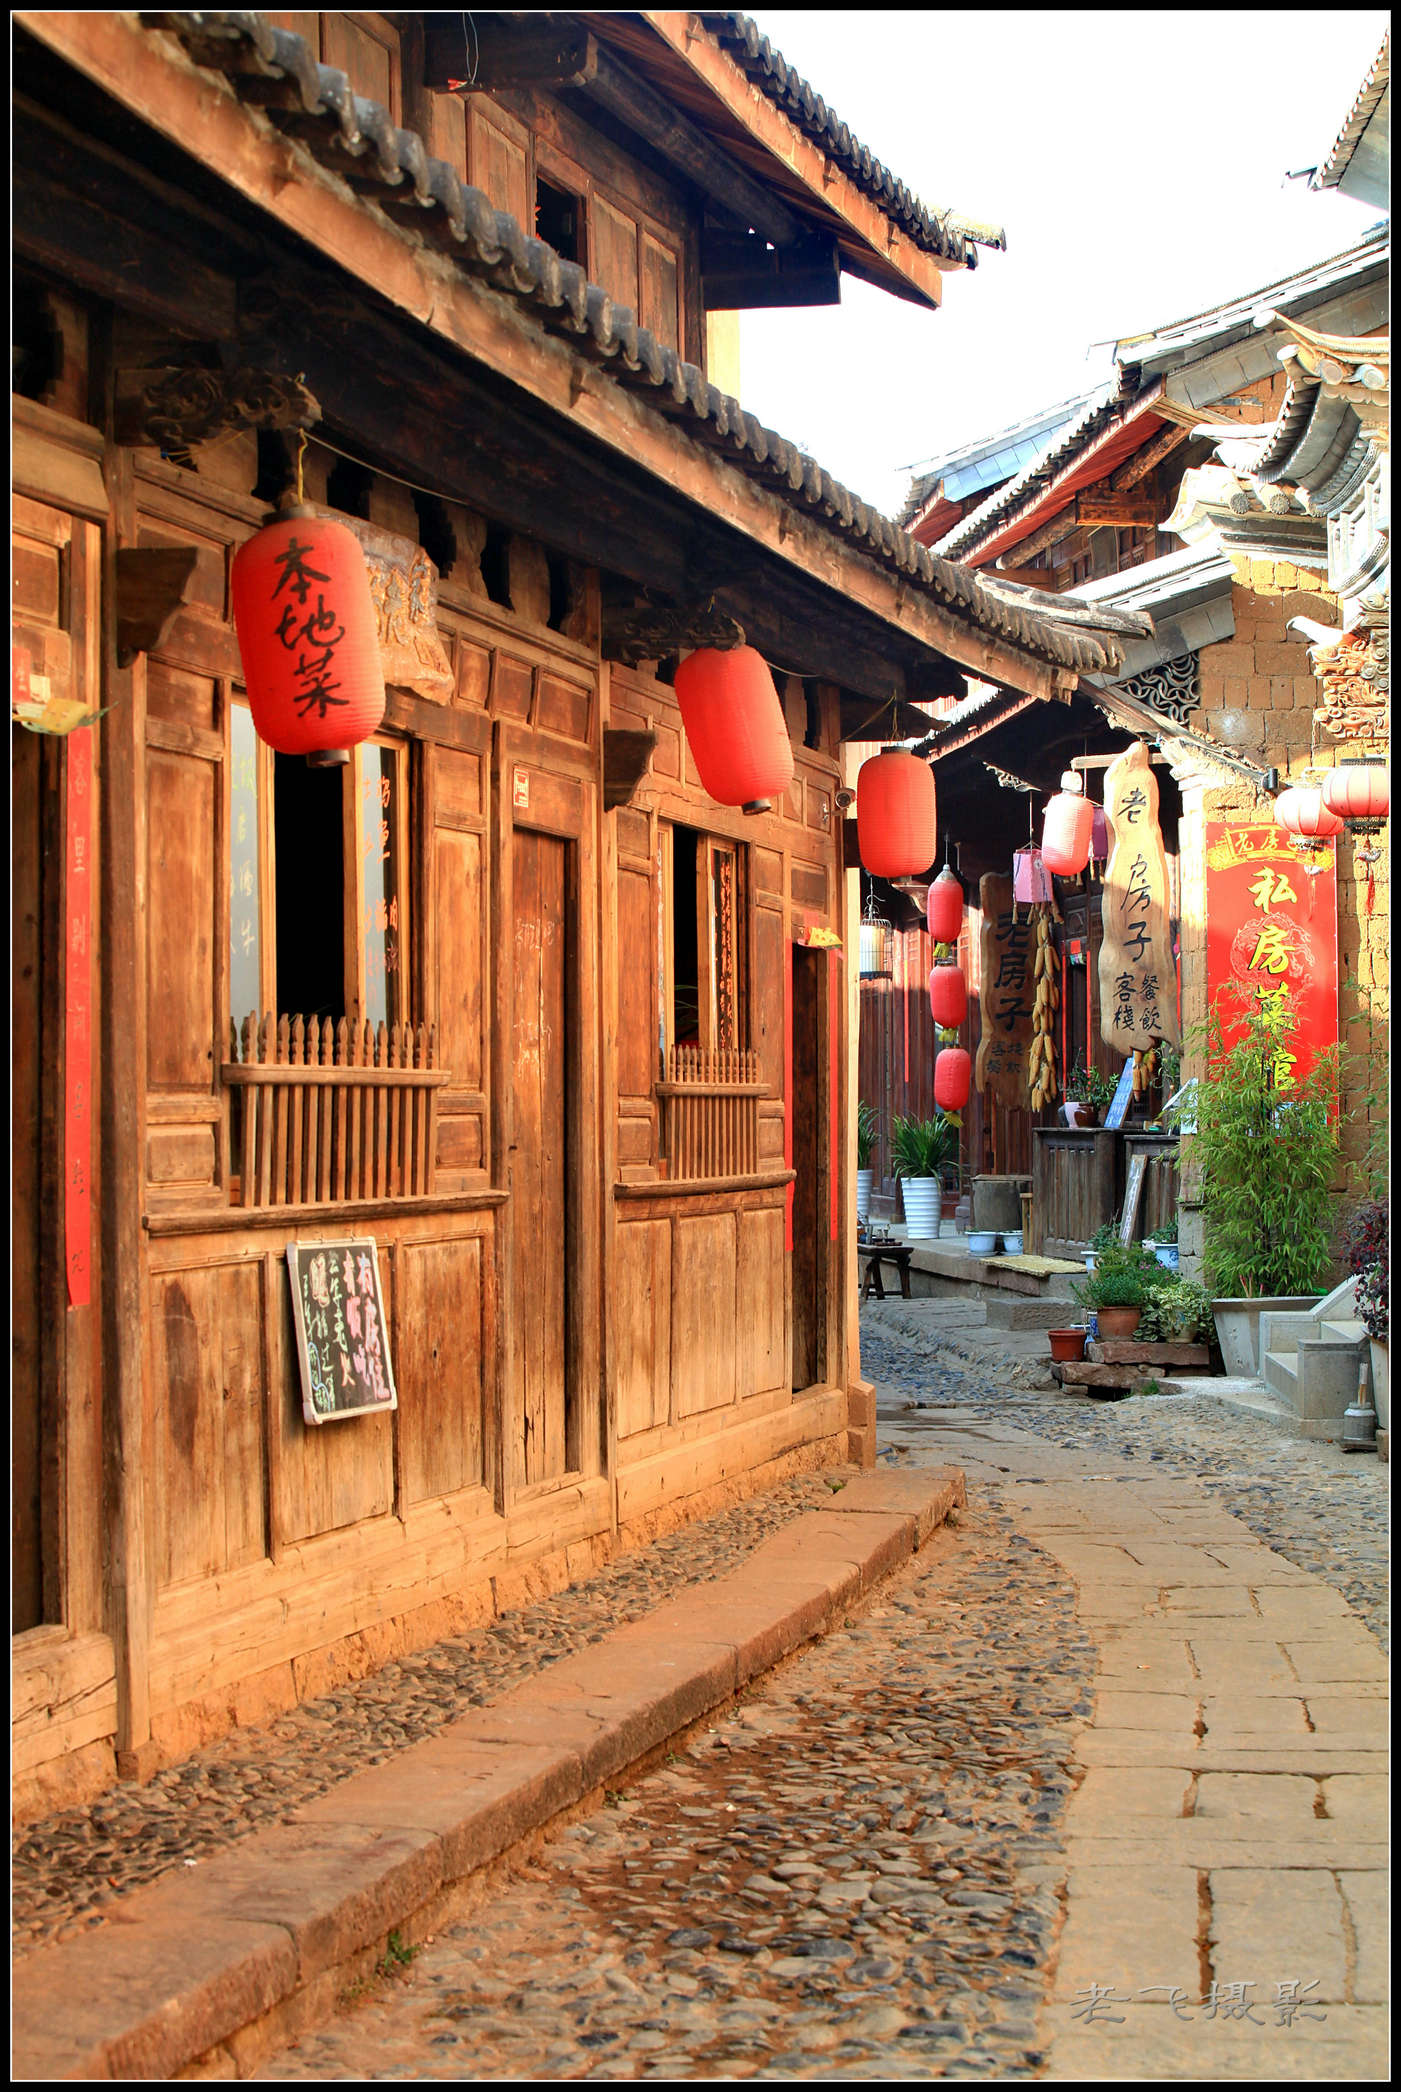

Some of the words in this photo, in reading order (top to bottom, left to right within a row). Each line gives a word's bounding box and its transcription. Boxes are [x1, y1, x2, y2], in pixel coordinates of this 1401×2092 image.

[272, 537, 350, 718] 本地菜
[1117, 787, 1152, 962] 老房子
